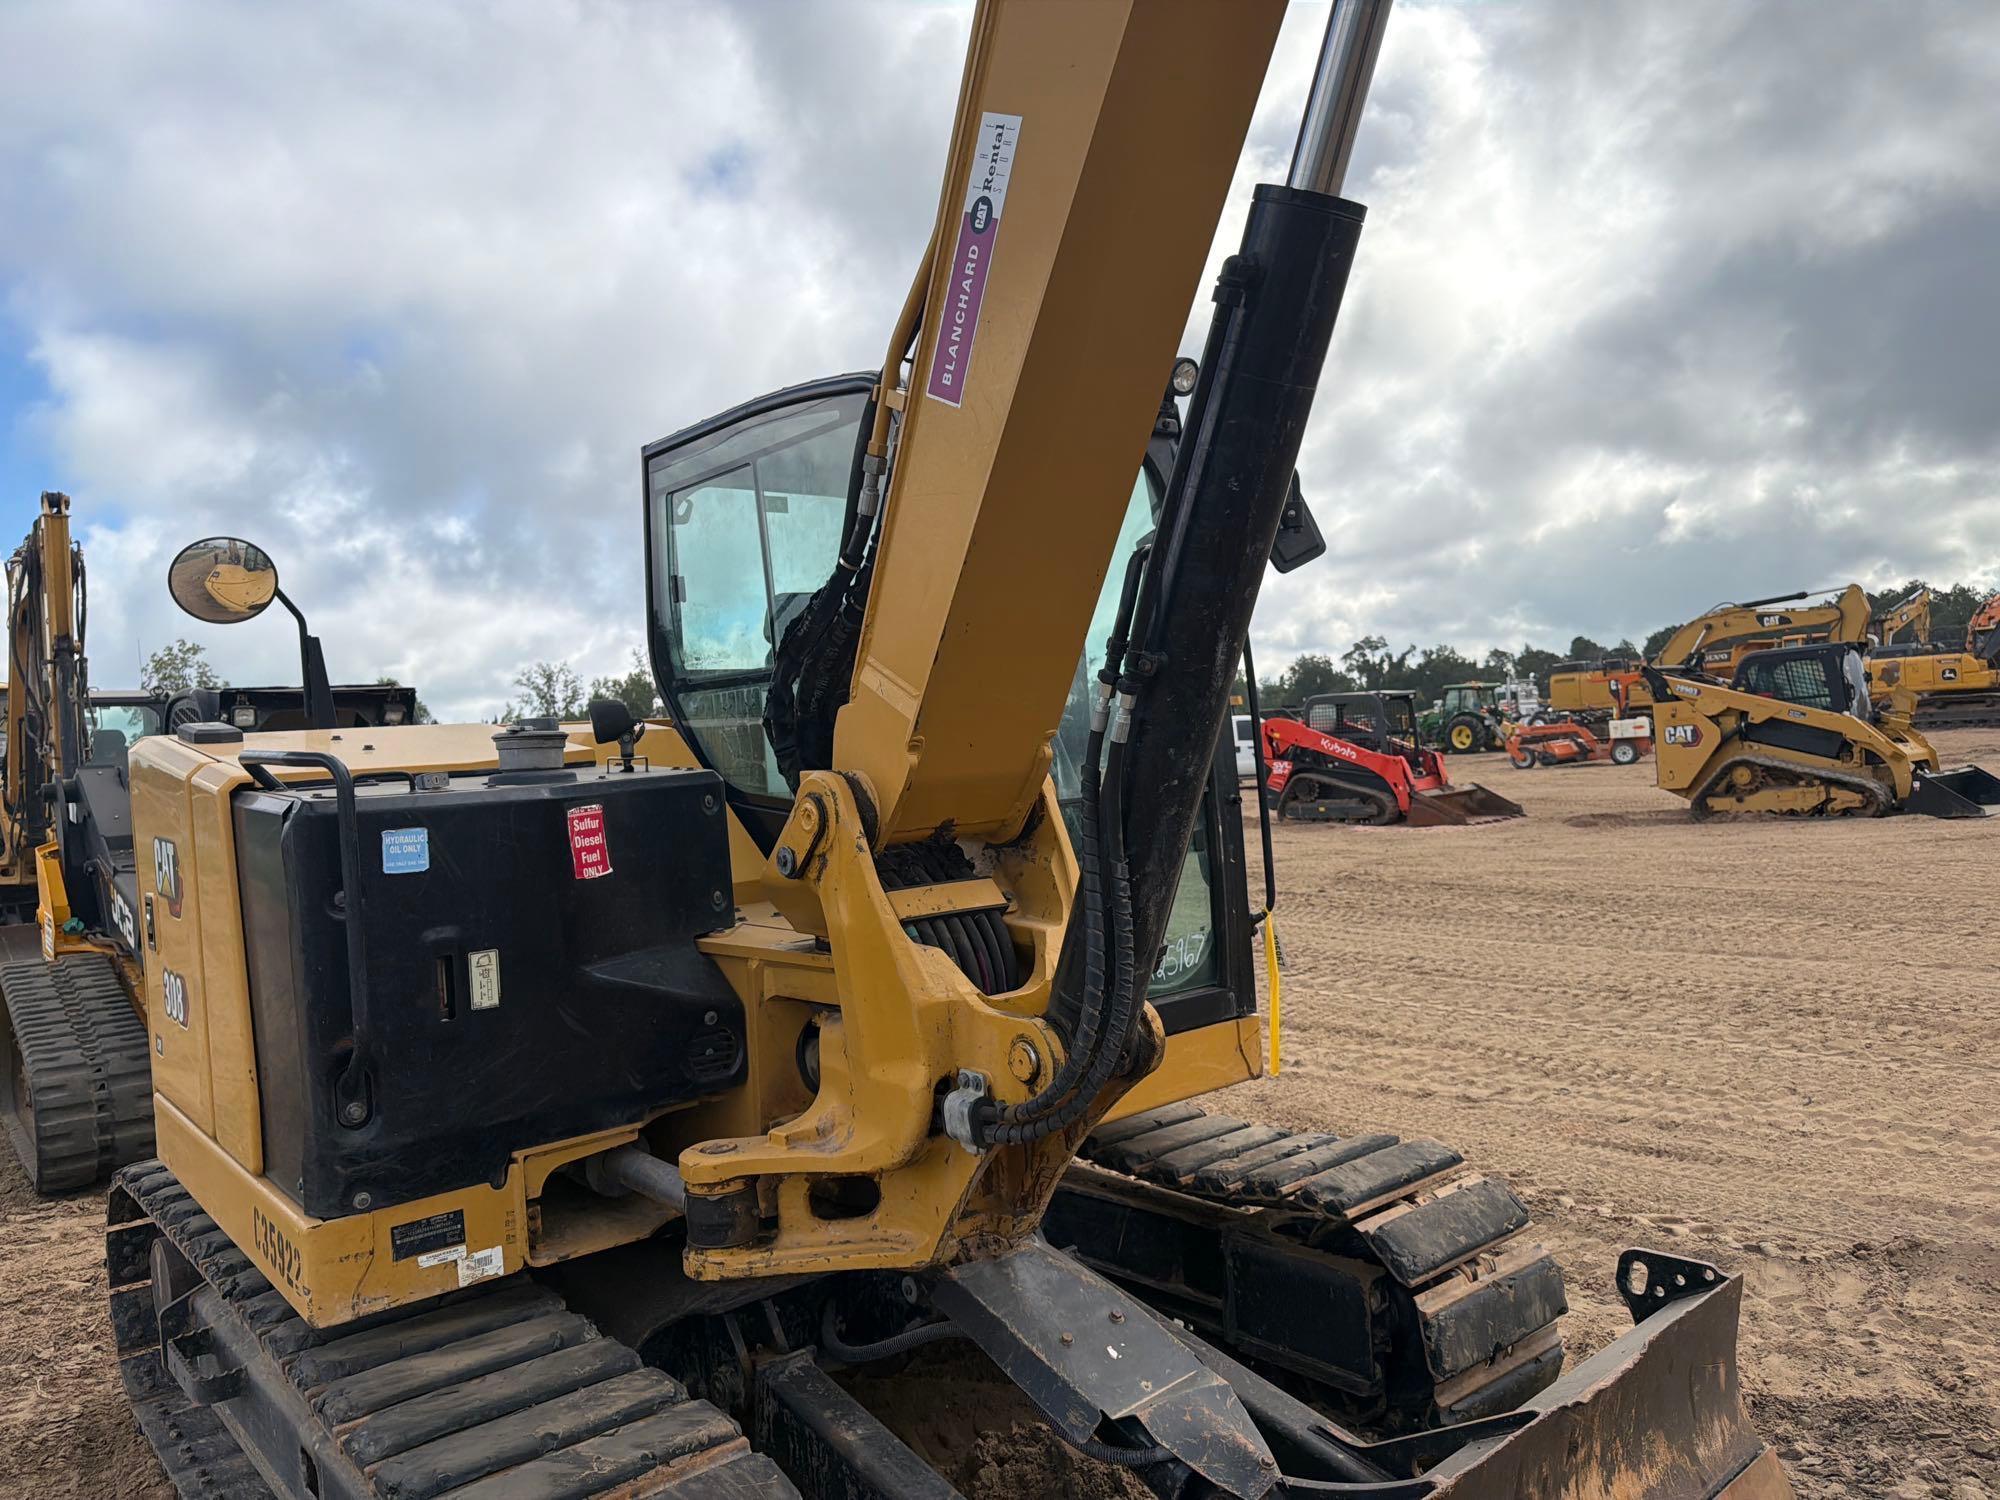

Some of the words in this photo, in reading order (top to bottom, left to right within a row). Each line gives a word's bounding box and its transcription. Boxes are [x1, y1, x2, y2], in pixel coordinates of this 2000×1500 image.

[942, 245, 979, 386] BLANCHARD
[975, 202, 989, 230] CAT
[982, 123, 1006, 194] Rental
[1763, 615, 1780, 627] CAT
[1704, 653, 1729, 662] LVO
[1665, 725, 1694, 745] CAT
[1320, 738, 1357, 760] Kubota
[573, 817, 600, 832] Sulfur
[385, 834, 425, 845] HYDRAULIC
[389, 845, 402, 854] OIL
[403, 843, 421, 853] ONLY
[574, 832, 603, 849] Diesel
[581, 849, 601, 865] Fuel
[154, 837, 176, 899] CAT
[583, 865, 604, 879] ONLY
[110, 886, 135, 950] JCB
[1151, 932, 1206, 982] 25967
[163, 971, 184, 1023] 308
[253, 1205, 303, 1297] C35922
